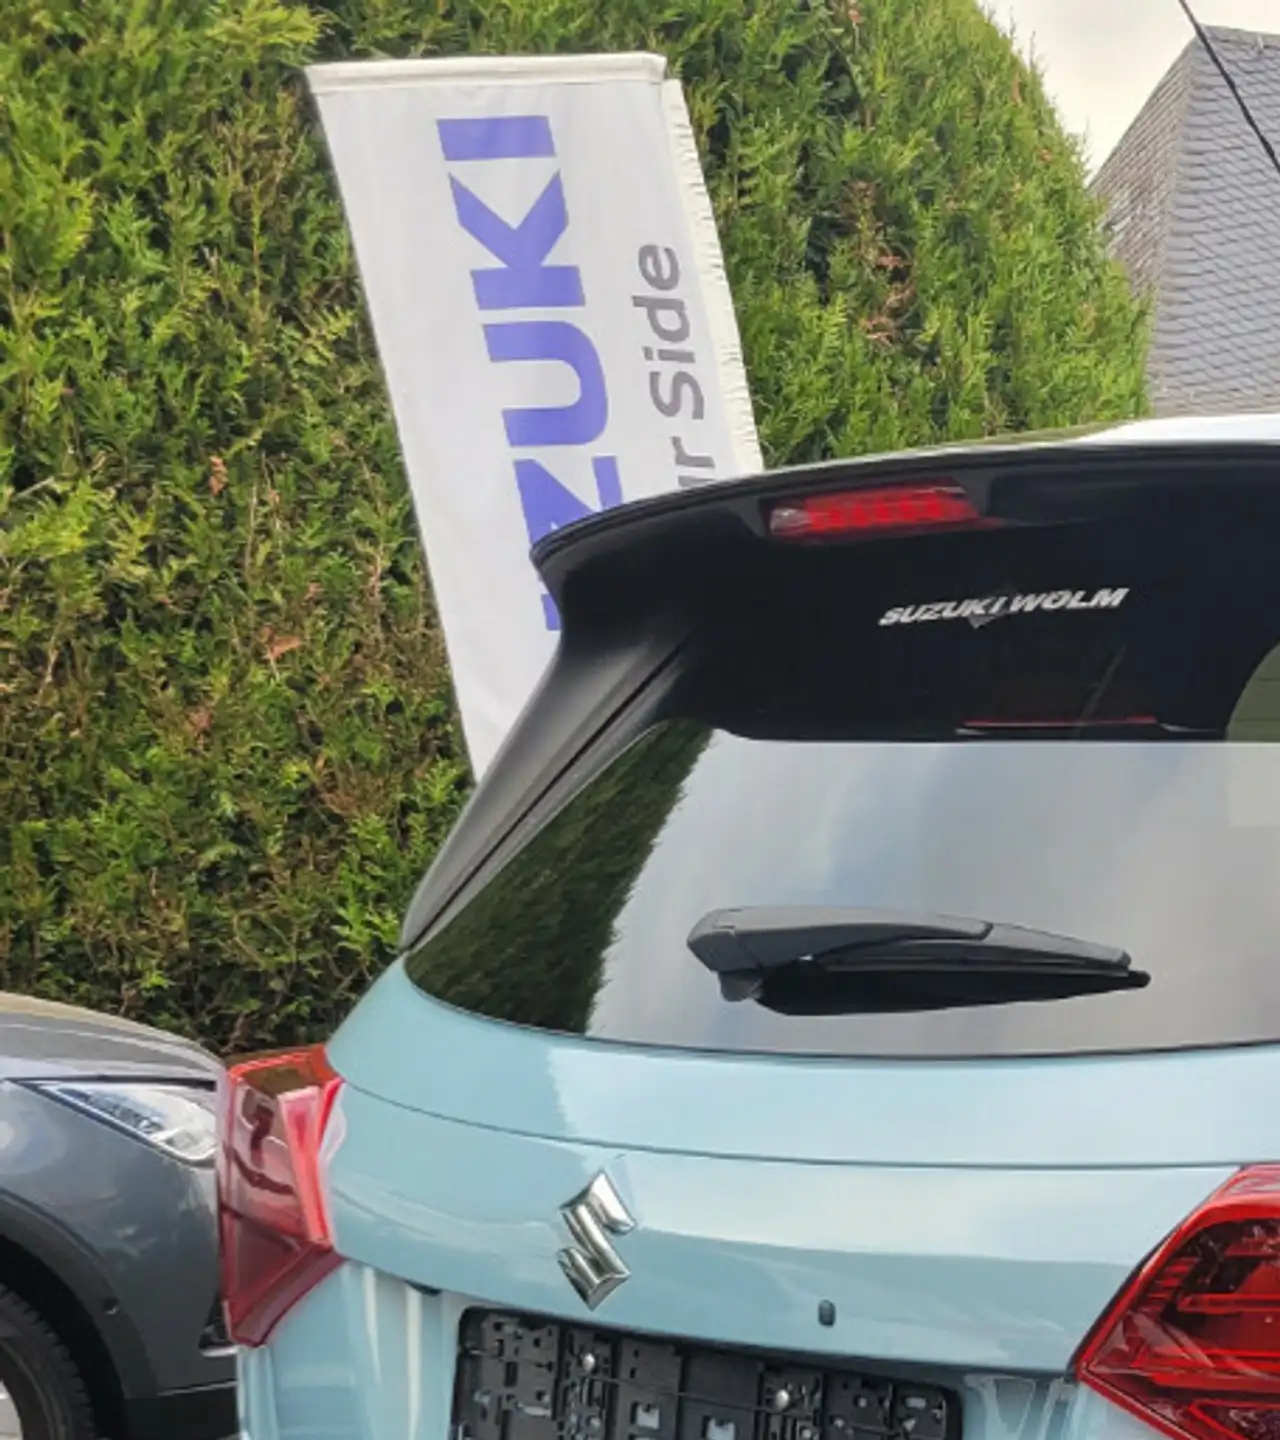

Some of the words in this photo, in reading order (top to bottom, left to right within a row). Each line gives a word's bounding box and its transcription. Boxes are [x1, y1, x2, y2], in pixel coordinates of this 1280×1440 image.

[436, 115, 625, 632] ZUKI
[632, 243, 705, 420] Side
[878, 596, 1008, 626] SUZUKI
